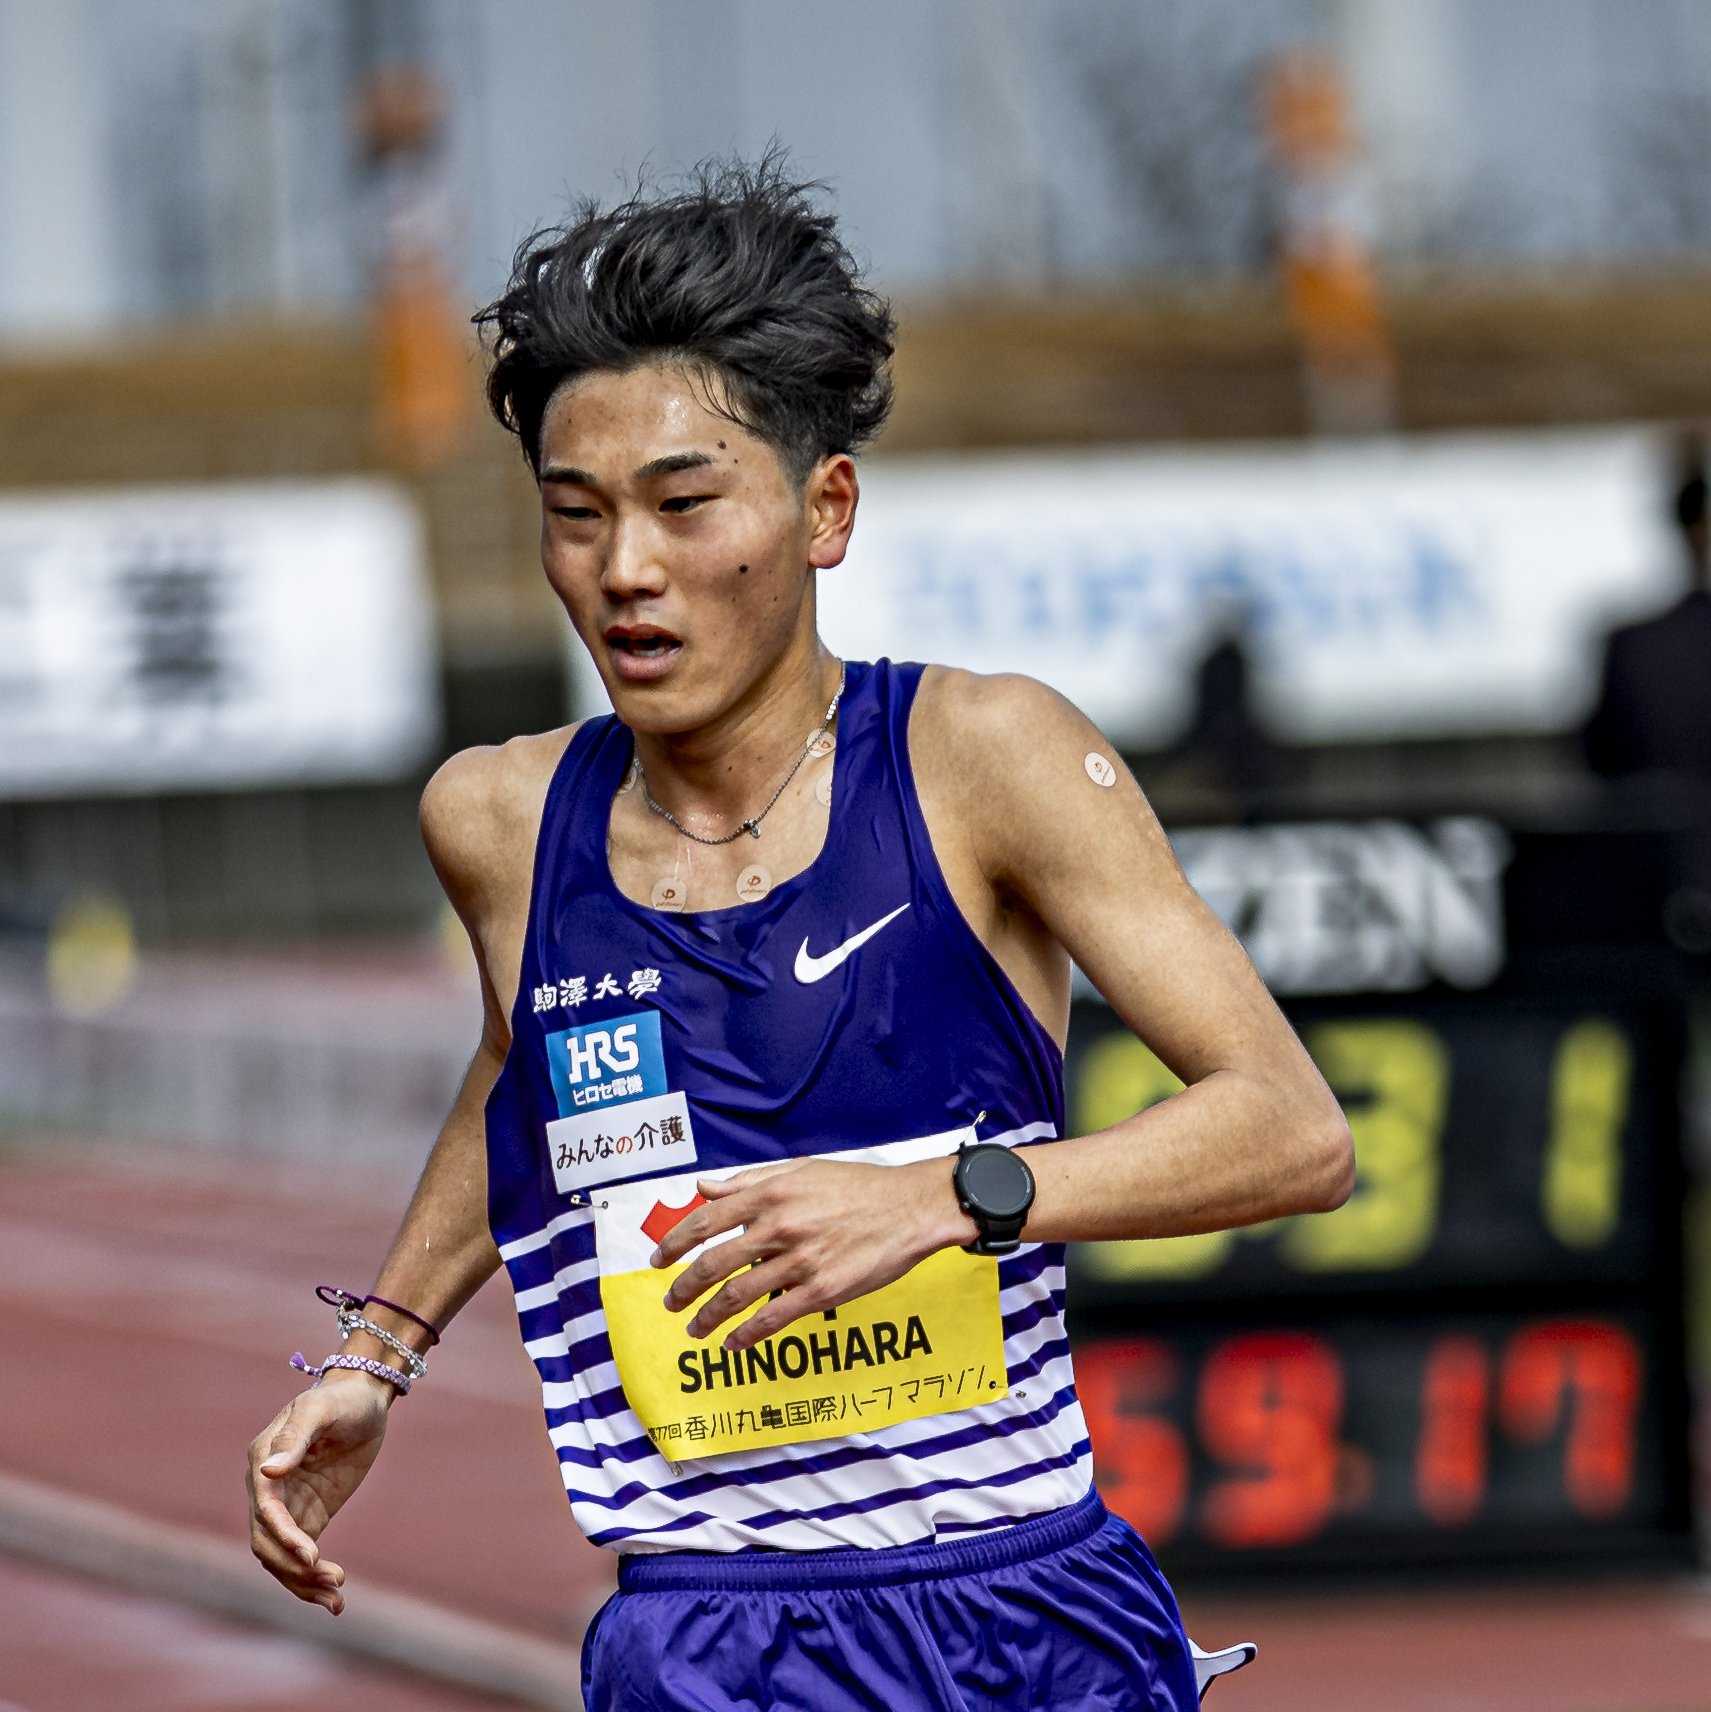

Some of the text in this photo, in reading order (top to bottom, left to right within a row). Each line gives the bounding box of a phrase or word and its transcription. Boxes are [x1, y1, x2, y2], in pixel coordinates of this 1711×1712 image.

[566, 1023, 639, 1085] HRS
[572, 1074, 644, 1106] ヒロセ電機
[556, 1116, 686, 1169] みんなの介護
[677, 1315, 933, 1393] SHINOHARA
